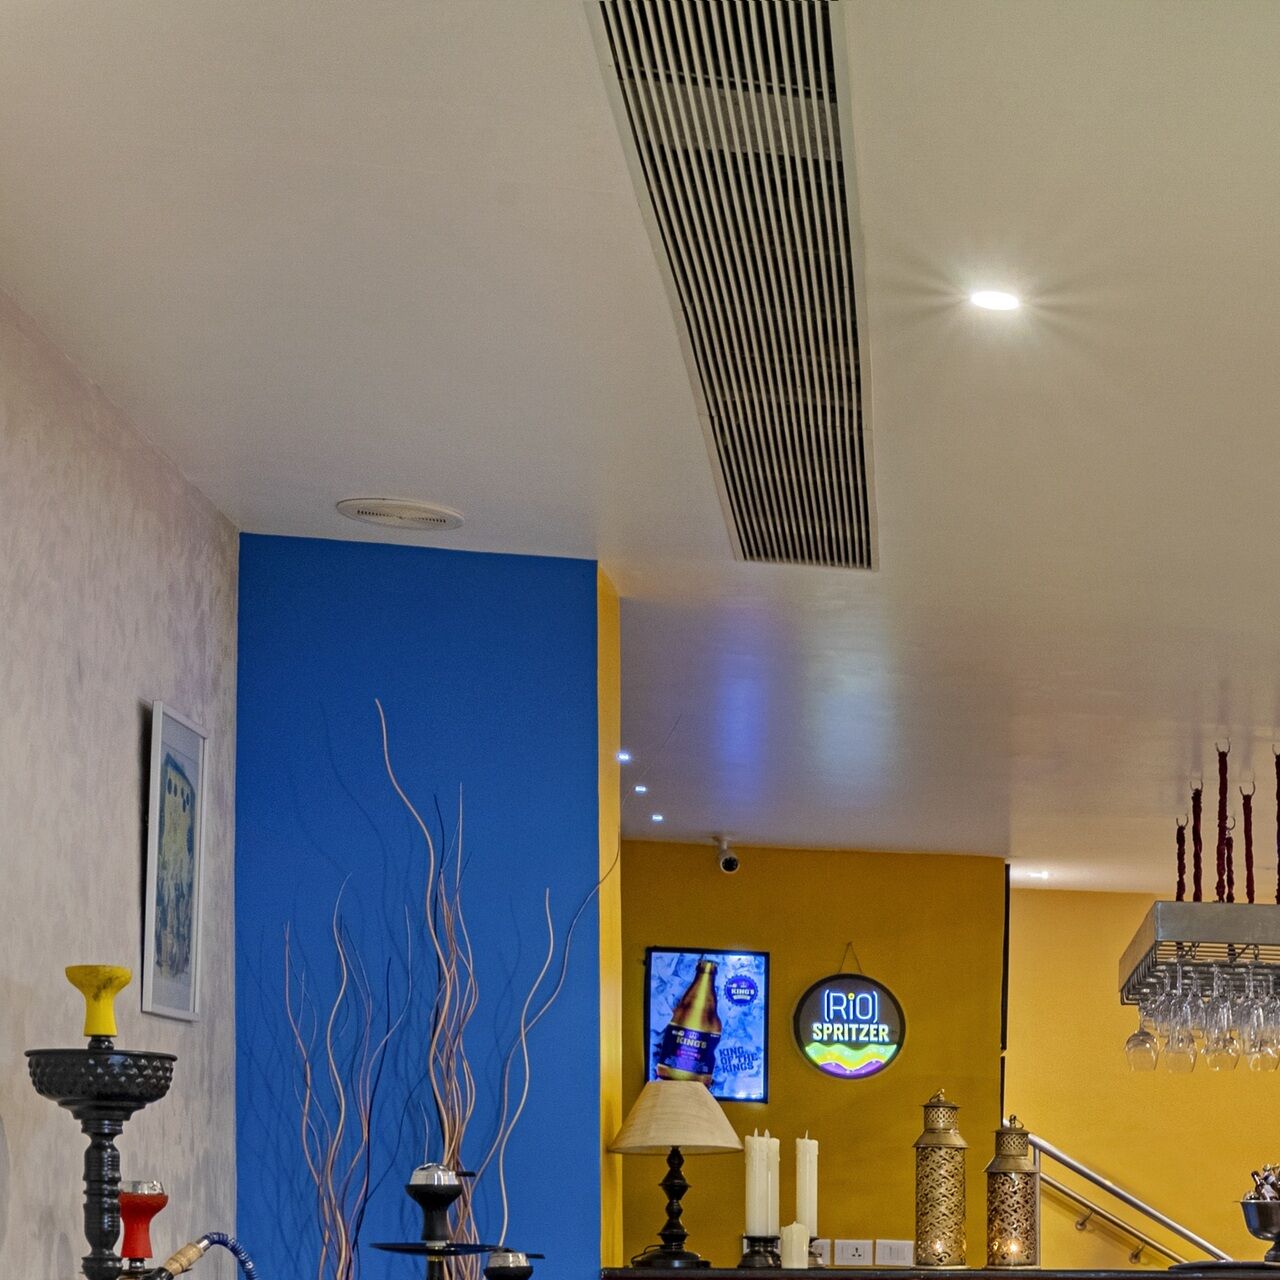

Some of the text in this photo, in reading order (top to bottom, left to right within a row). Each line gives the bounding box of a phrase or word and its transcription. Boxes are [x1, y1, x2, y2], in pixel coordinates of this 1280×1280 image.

[812, 1022, 890, 1042] SPRITZER
[719, 1046, 745, 1058] KING
[720, 1052, 759, 1066] OF THE
[722, 1062, 755, 1074] KINGS
